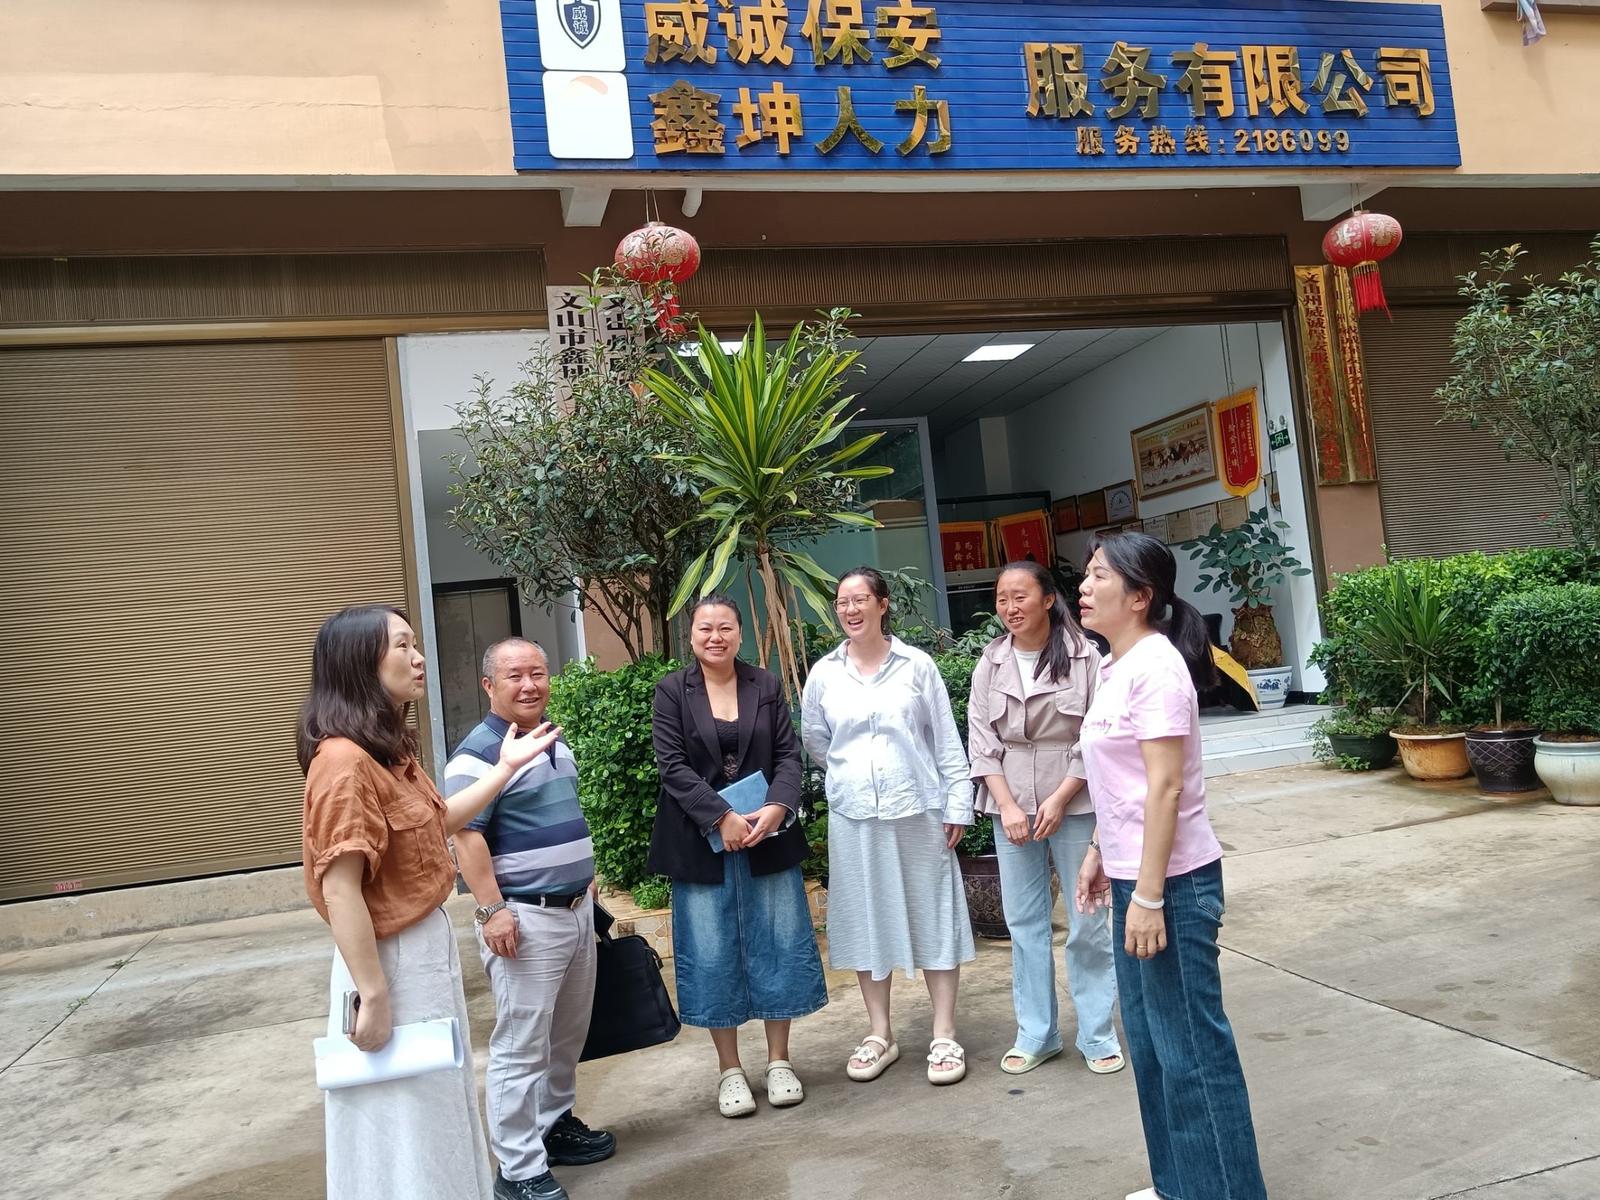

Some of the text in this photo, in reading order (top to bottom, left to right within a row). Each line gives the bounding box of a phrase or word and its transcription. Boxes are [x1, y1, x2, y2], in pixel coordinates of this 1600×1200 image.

[644, 0, 942, 70] 威诚保安
[648, 79, 952, 155] 鑫坤人力
[1023, 41, 1436, 120] 服务有限公司
